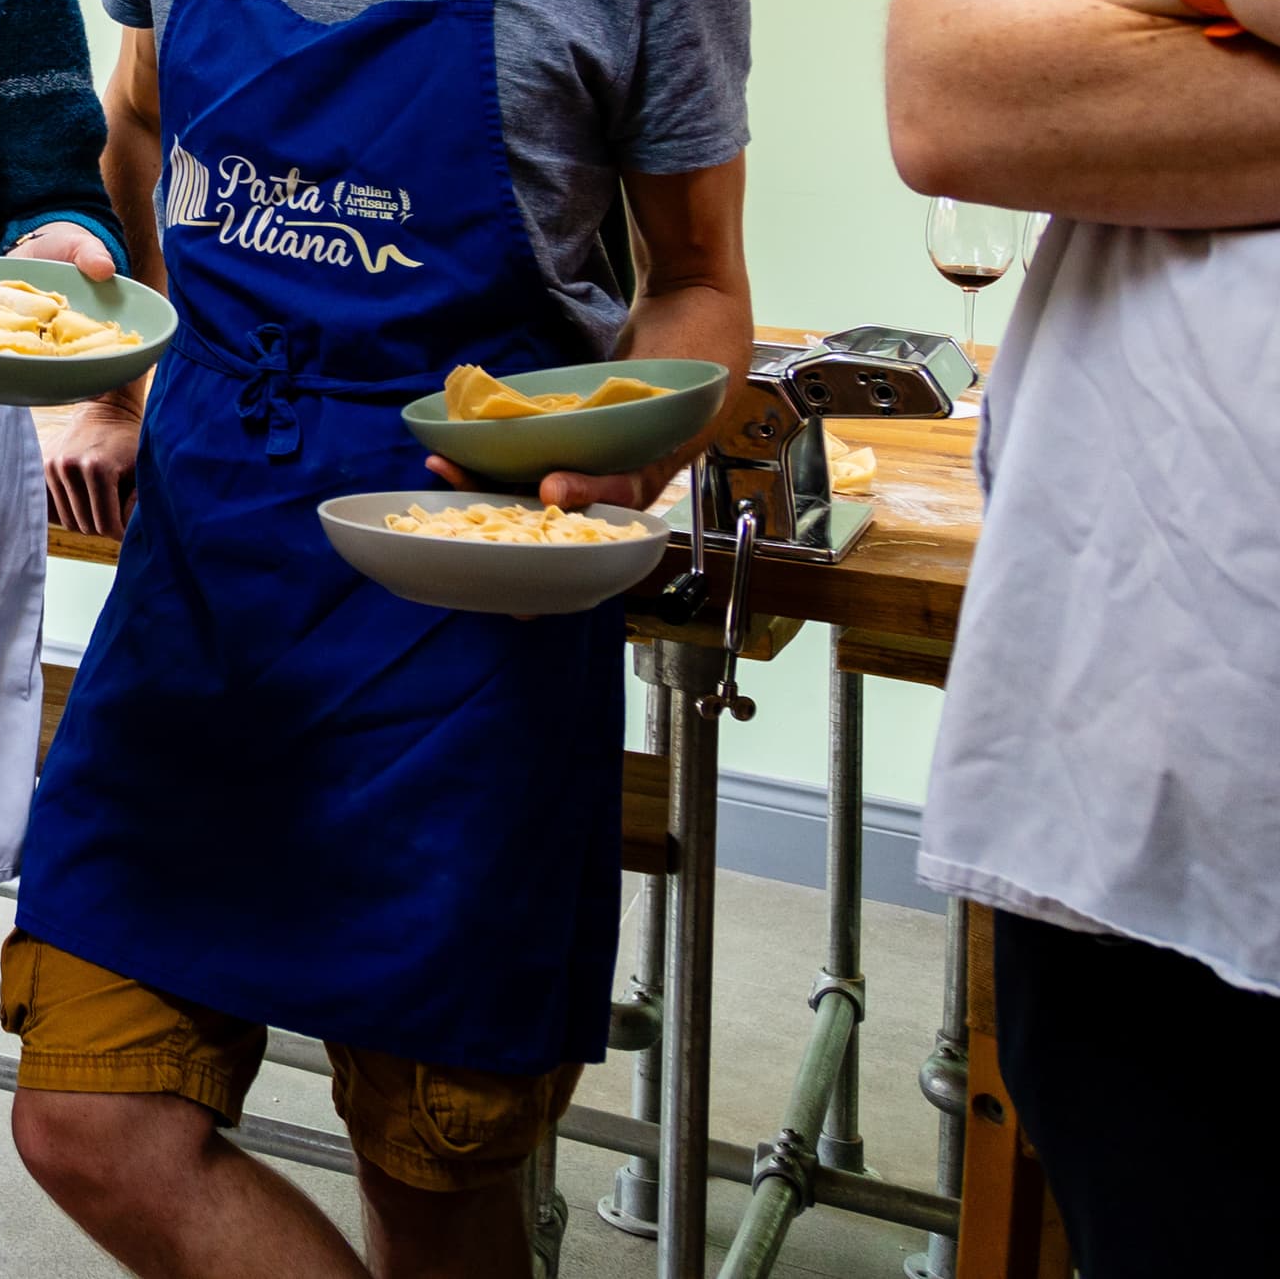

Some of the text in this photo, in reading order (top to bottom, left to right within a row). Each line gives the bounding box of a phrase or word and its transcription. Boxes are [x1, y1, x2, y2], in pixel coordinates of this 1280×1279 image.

[217, 155, 325, 214] Pasta
[349, 183, 392, 199] Italian
[344, 194, 399, 211] Artisans
[347, 207, 394, 220] IN THE UK
[215, 202, 354, 266] Uliana
